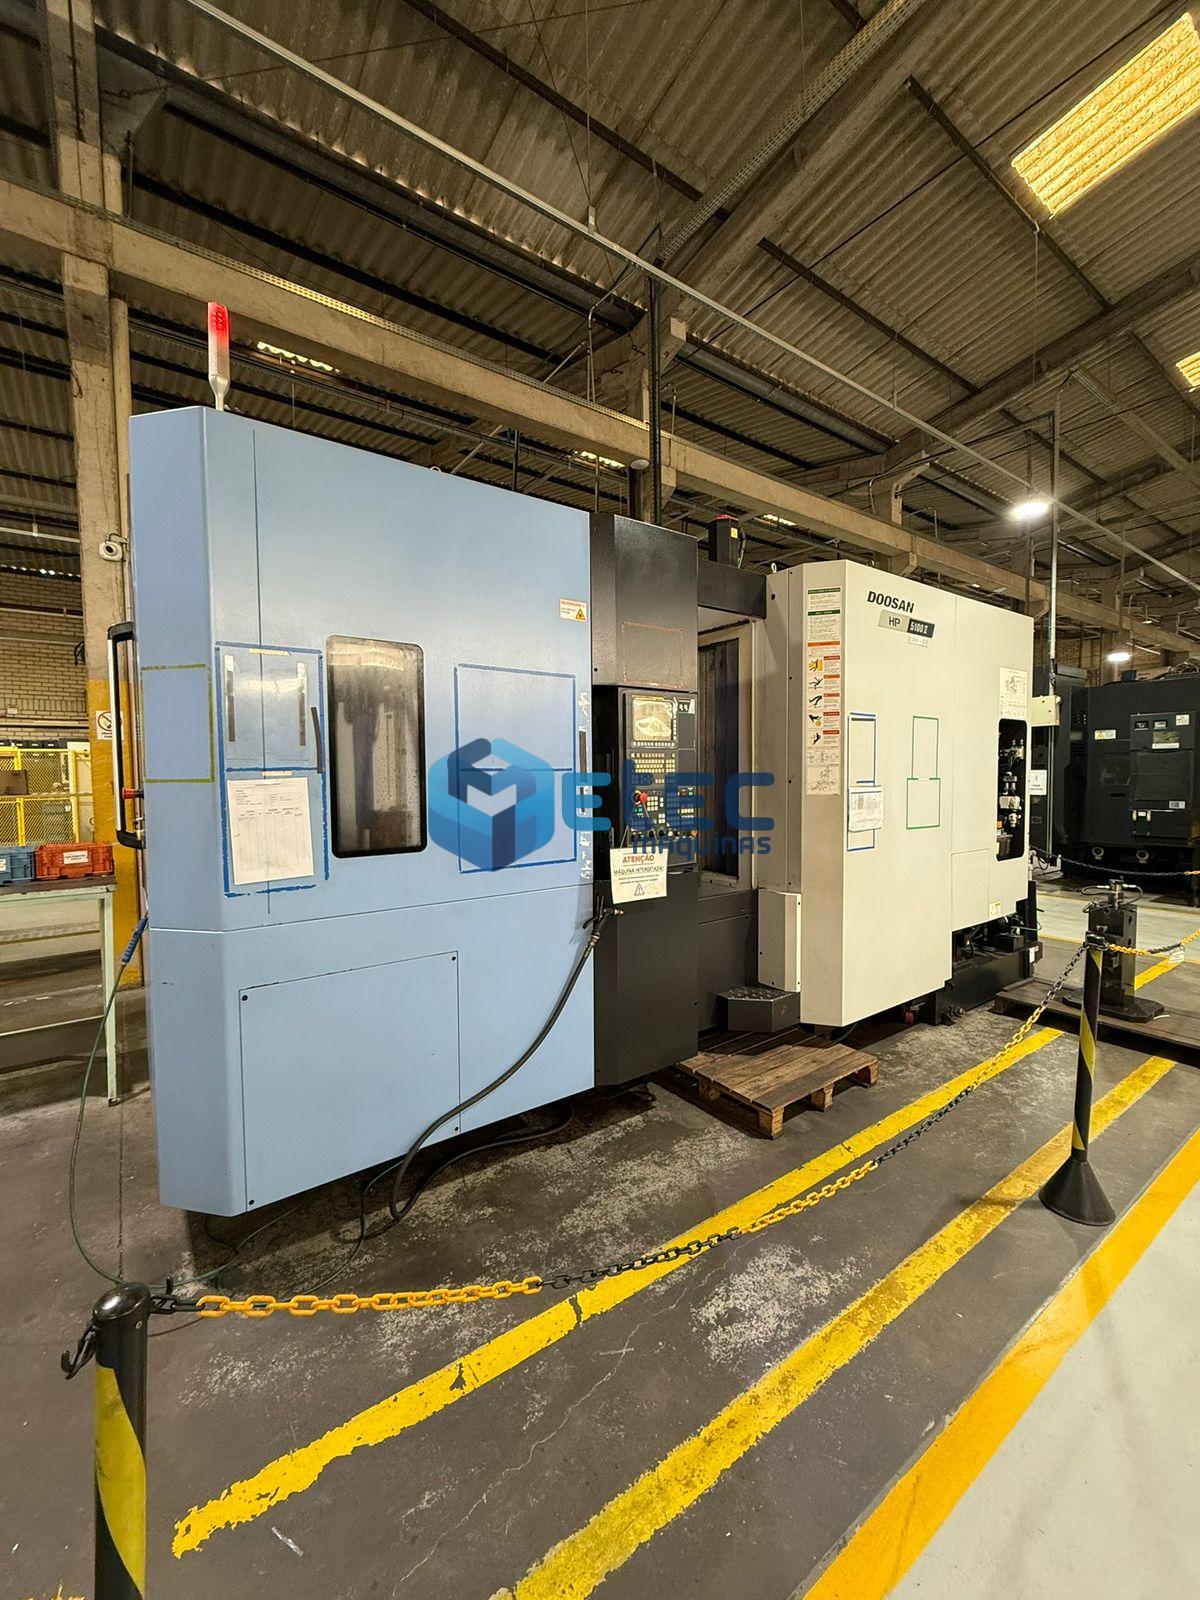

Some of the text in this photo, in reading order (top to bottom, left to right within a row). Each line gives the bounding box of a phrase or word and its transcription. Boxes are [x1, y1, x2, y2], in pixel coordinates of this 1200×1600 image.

[867, 590, 914, 613] DOOSAN
[888, 616, 900, 626] HP
[623, 854, 654, 864] ATENÇÃO
